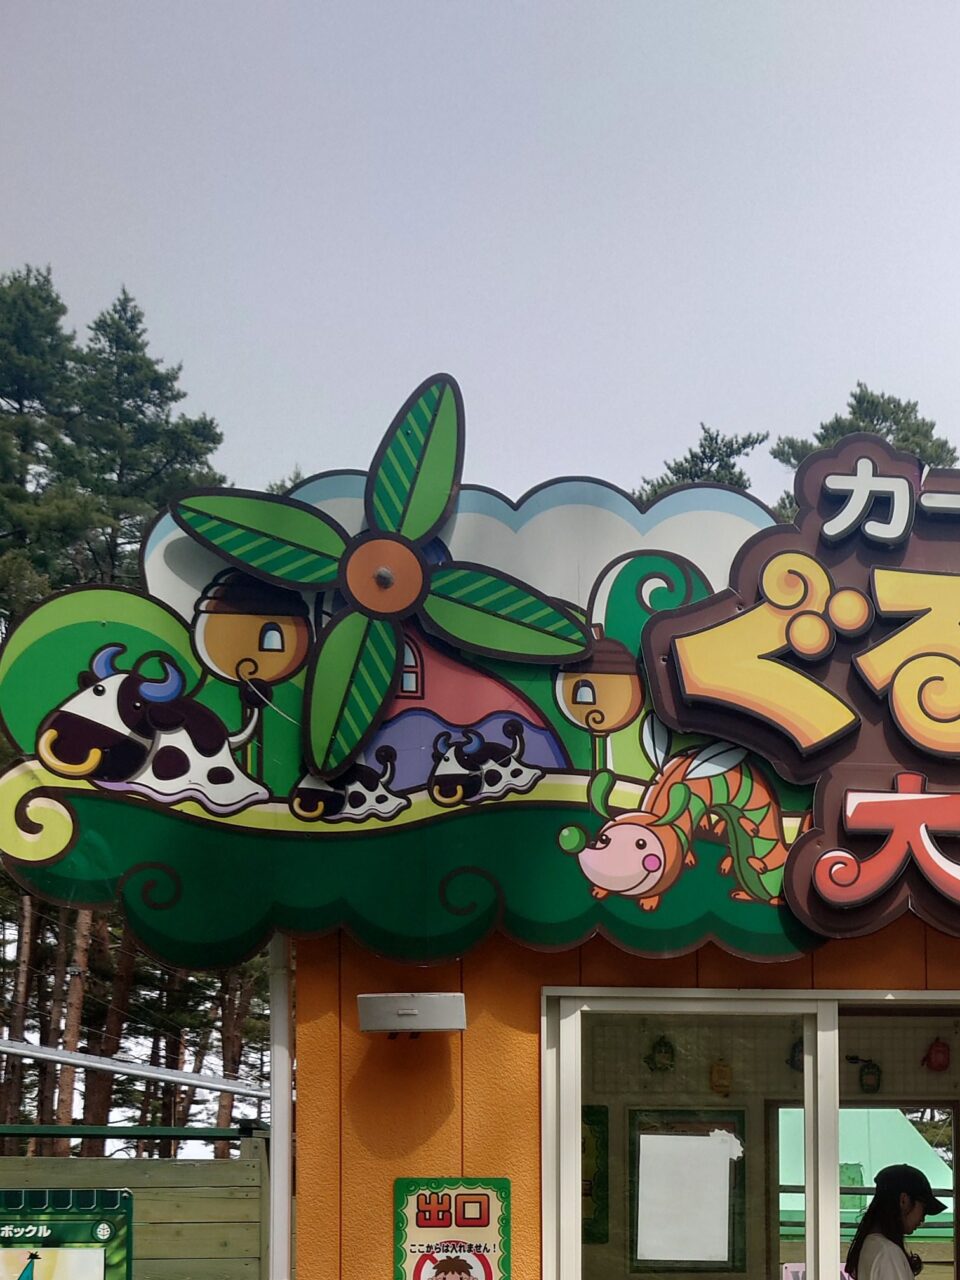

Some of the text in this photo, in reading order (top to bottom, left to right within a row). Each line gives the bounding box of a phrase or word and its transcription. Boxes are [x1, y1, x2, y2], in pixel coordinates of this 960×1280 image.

[416, 1192, 490, 1228] 出口
[0, 1224, 52, 1238] ボックル
